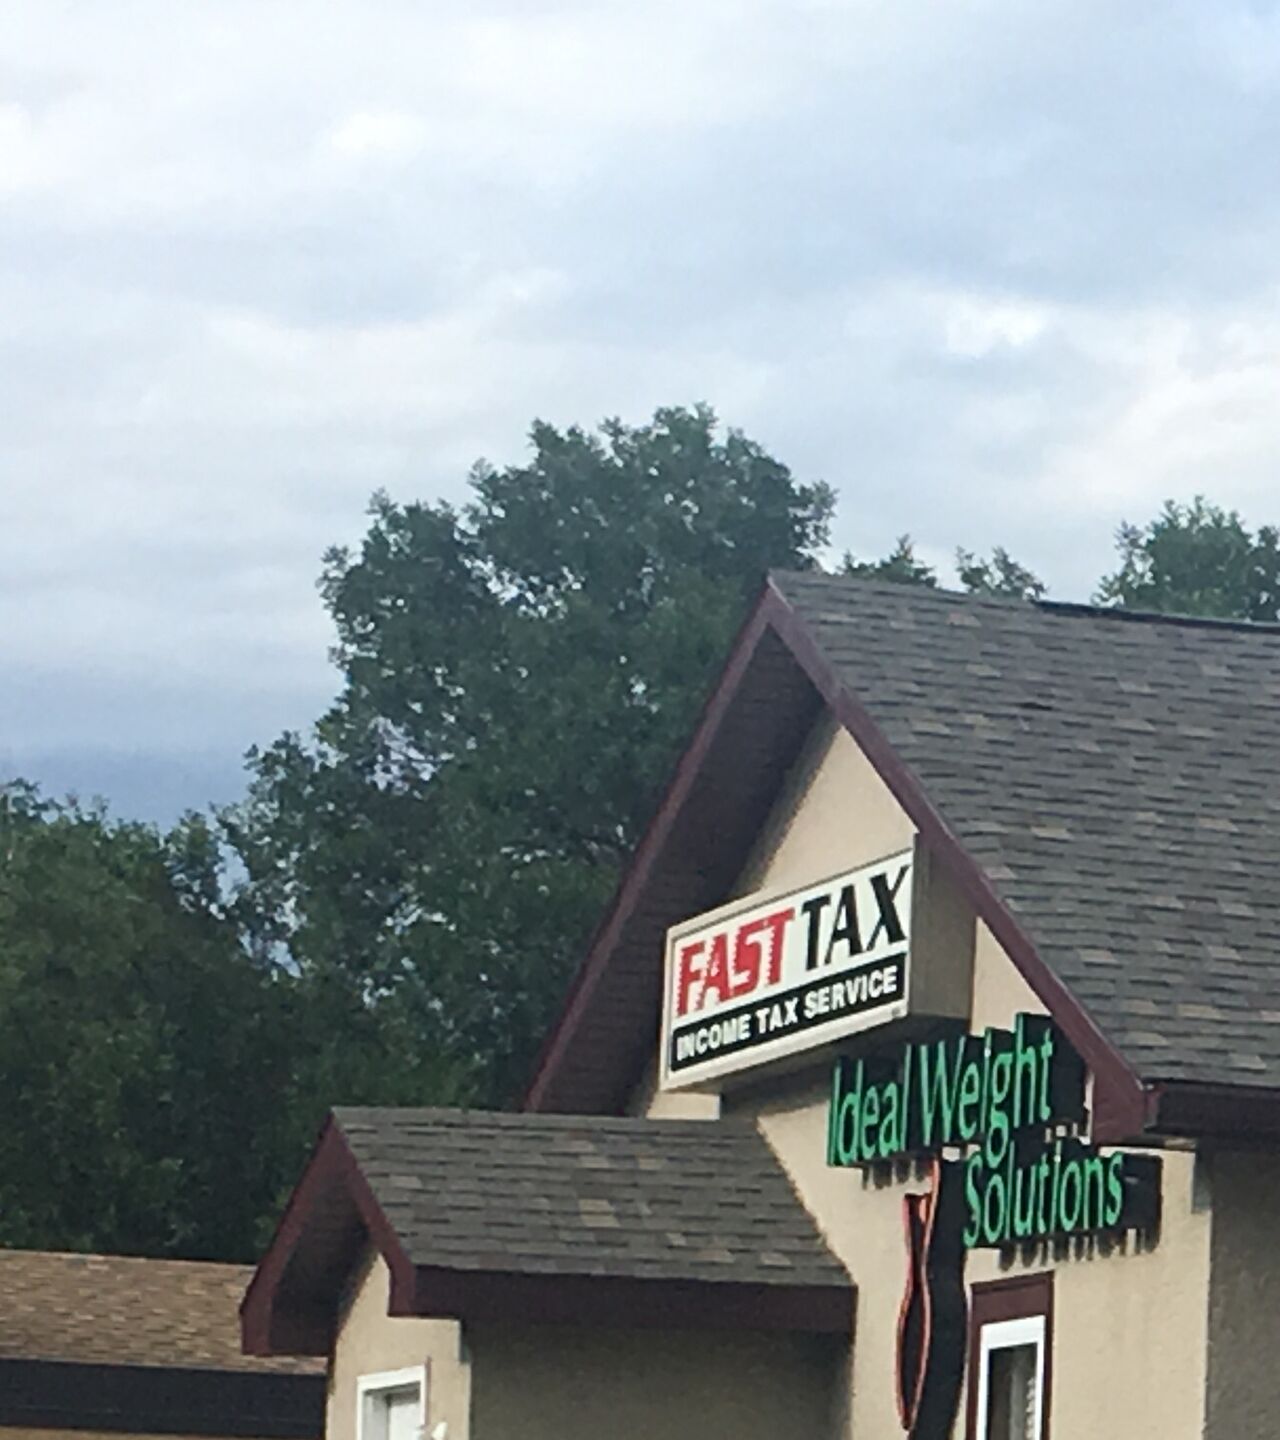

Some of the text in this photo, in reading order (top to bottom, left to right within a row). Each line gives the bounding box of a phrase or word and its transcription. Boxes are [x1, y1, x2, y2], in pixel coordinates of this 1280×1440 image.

[677, 865, 910, 1017] FAST TAX
[676, 965, 898, 1061] INCOME TAX SERVICE
[828, 1012, 1053, 1168] Ideal Weight
[963, 1140, 1123, 1248] Solutions
